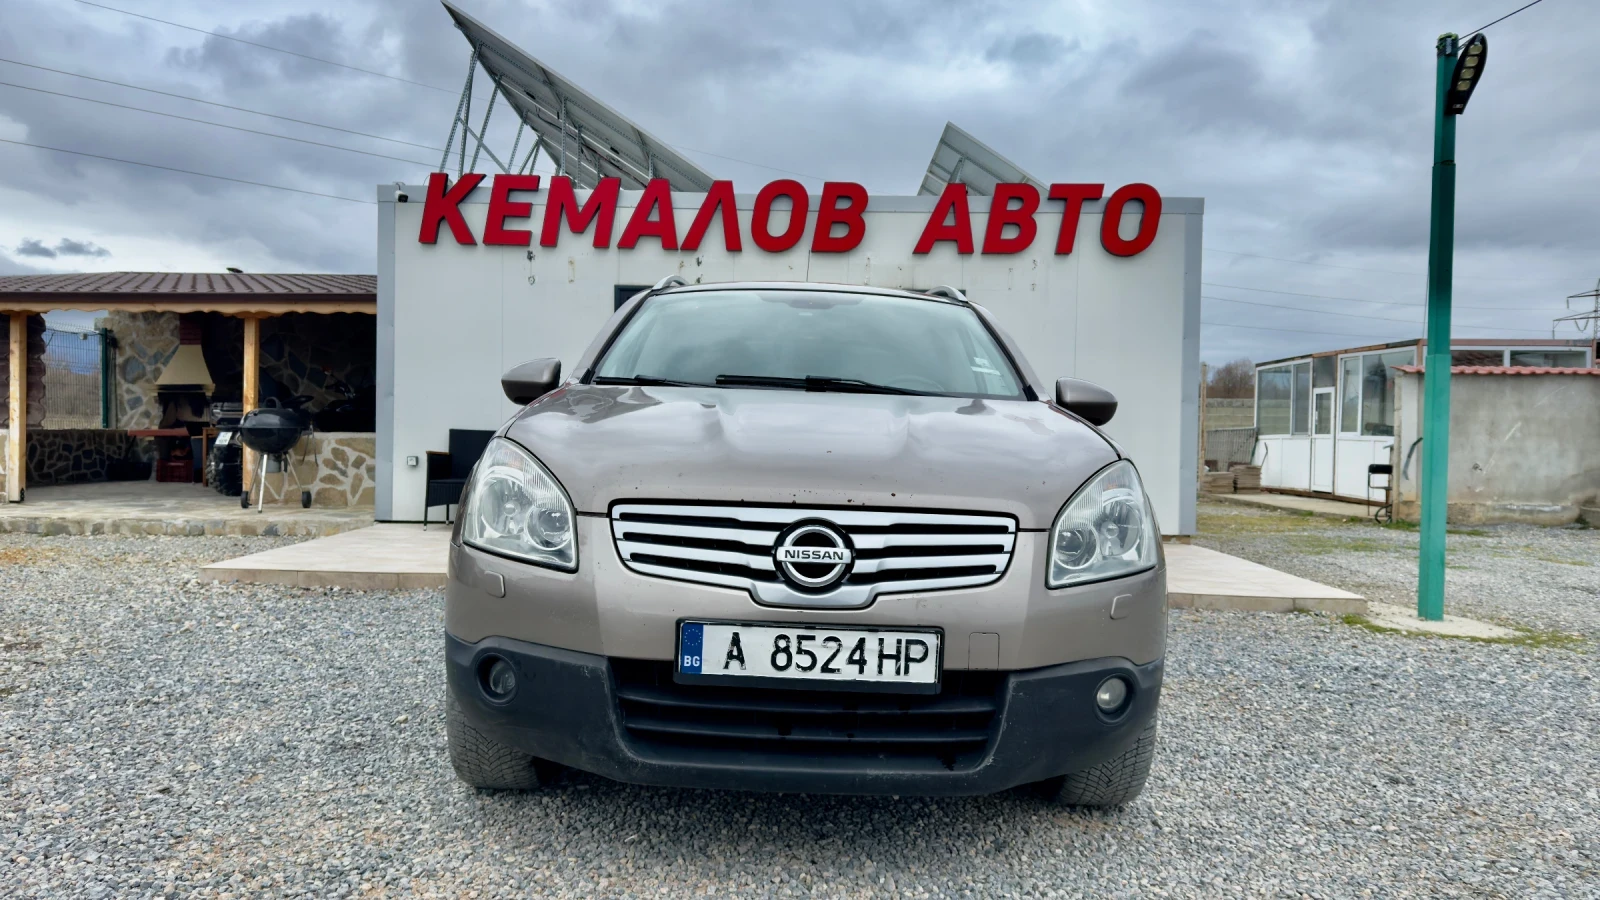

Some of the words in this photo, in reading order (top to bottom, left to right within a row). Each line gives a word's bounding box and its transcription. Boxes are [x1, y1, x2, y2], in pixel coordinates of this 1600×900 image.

[418, 172, 869, 254] КЕМАЛОВ
[912, 182, 1163, 257] АВТО
[784, 549, 844, 561] NISSAN
[684, 655, 701, 667] BG
[723, 632, 747, 670] A
